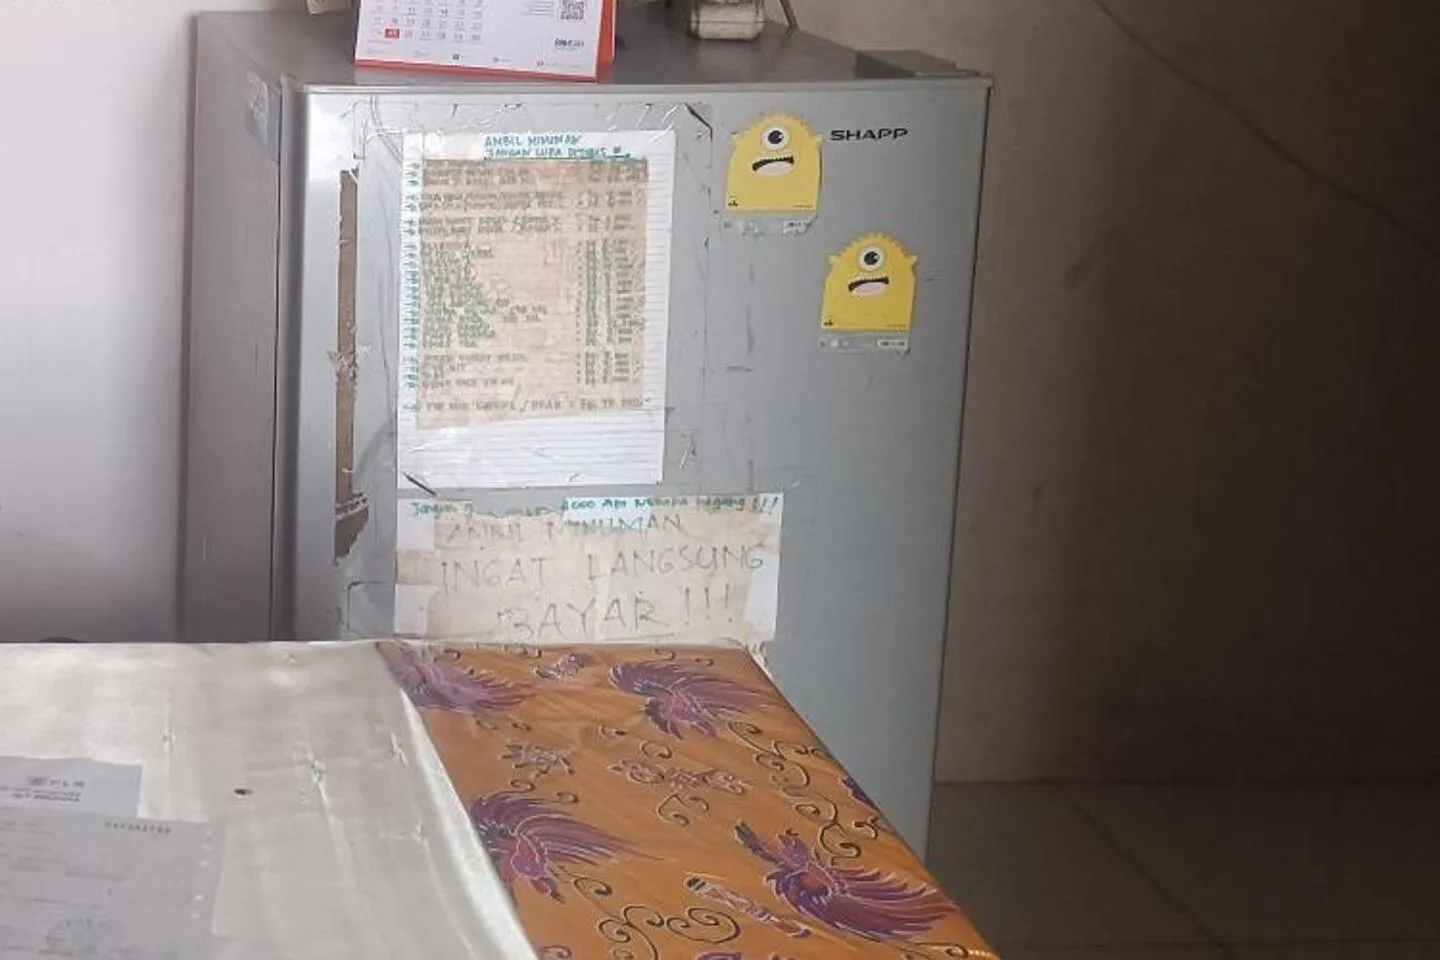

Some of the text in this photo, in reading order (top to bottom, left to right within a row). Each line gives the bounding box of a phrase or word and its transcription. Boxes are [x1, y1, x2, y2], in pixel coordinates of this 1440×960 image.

[441, 543, 770, 593] INGAT LANGSUNG
[497, 591, 670, 640] BAYAR
